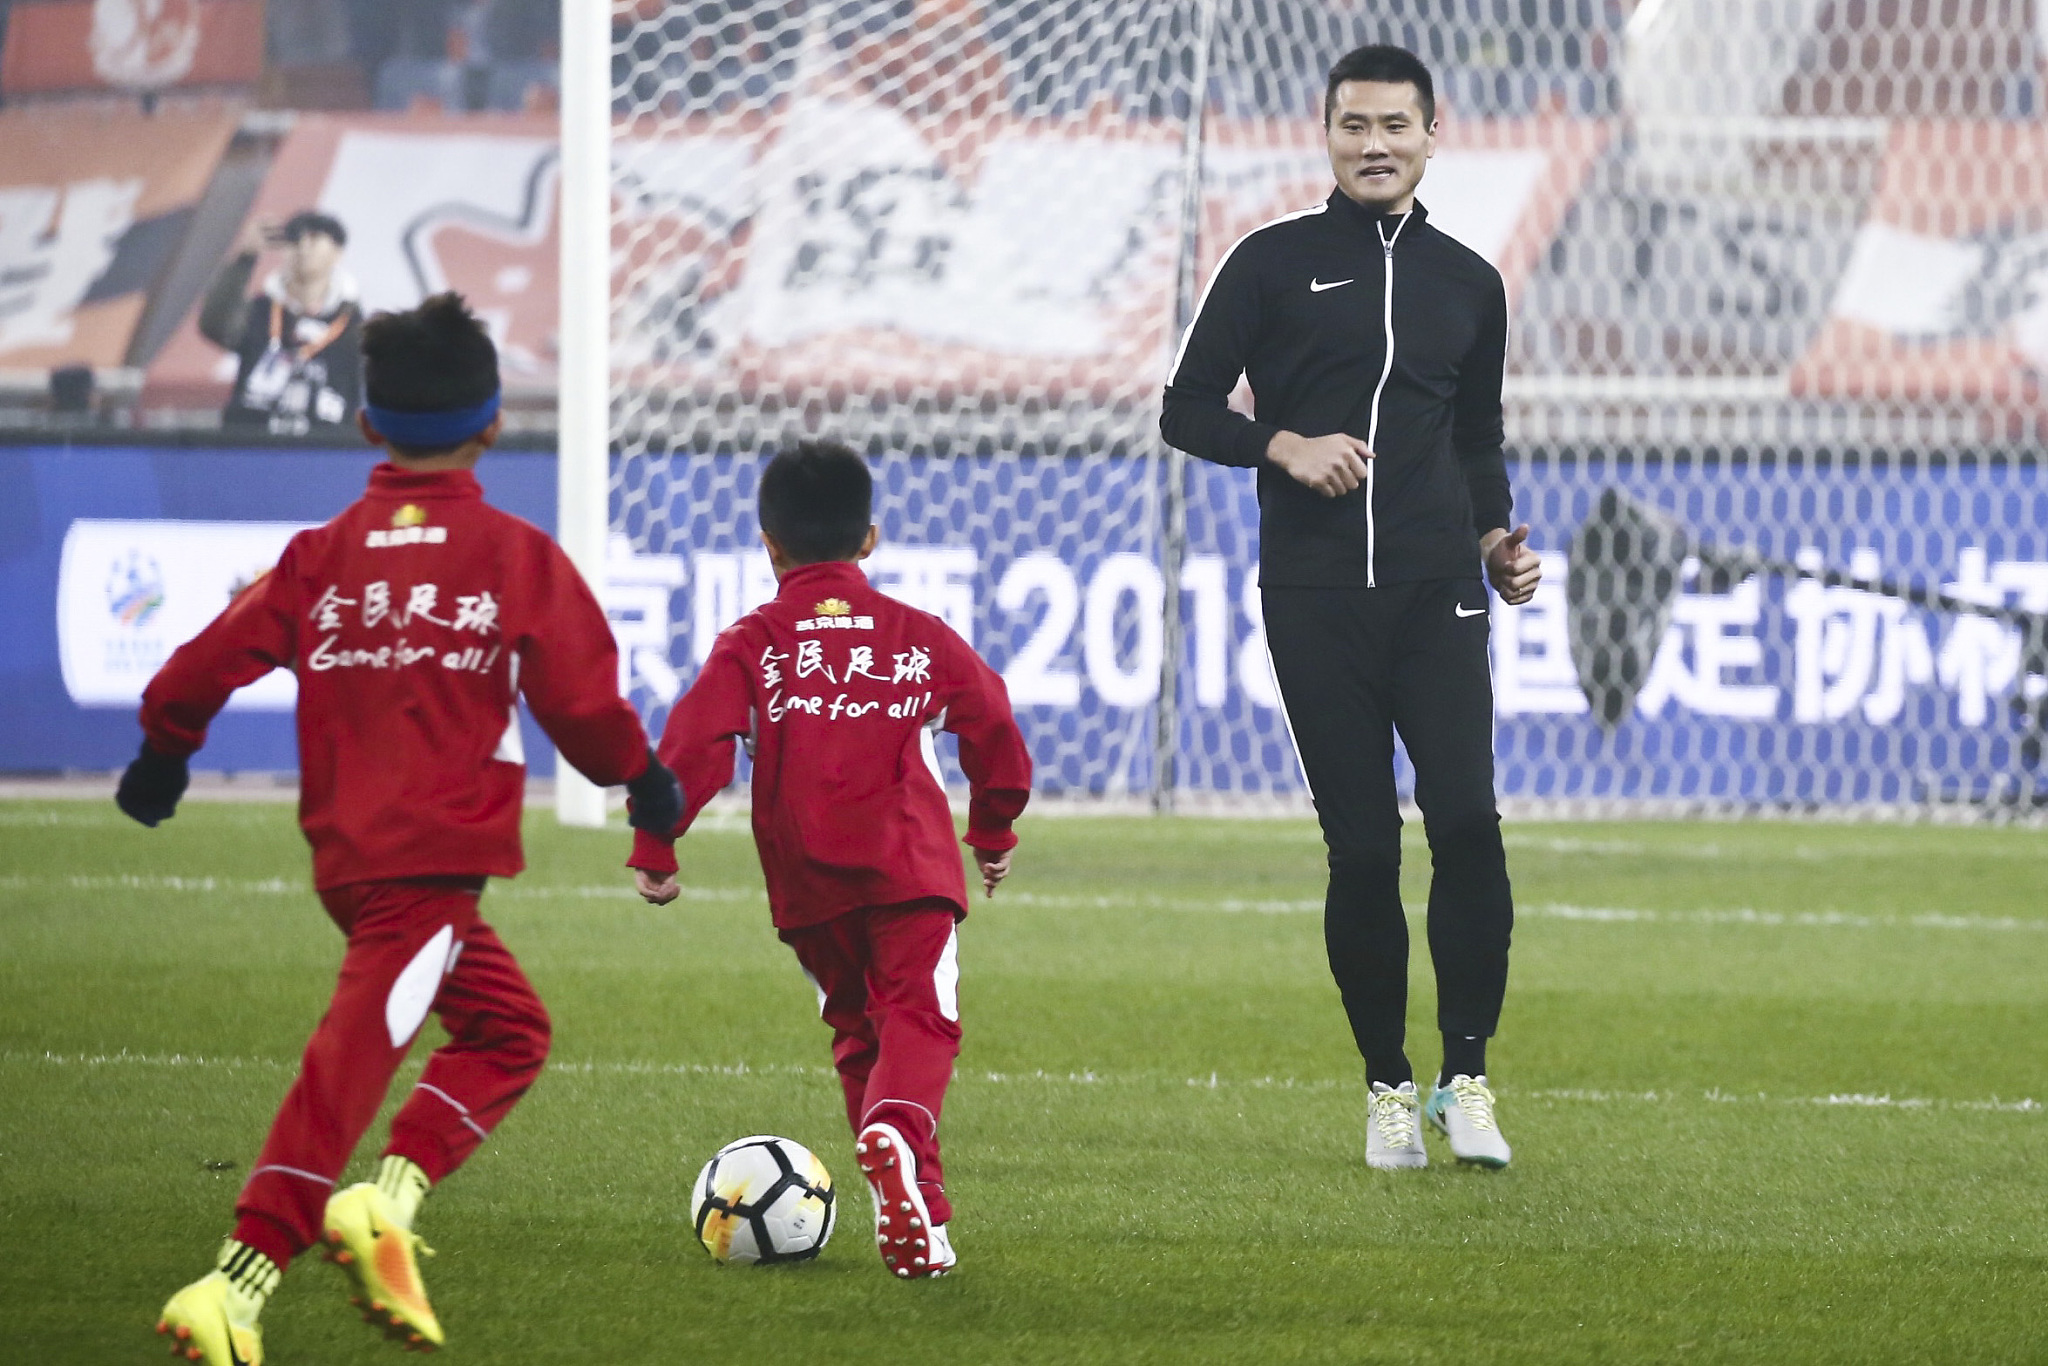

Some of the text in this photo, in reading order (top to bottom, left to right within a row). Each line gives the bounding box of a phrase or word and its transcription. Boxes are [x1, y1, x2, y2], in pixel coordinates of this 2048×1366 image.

[309, 580, 499, 636] 全民足球
[308, 634, 391, 670] Game
[760, 639, 931, 689] 全民足球
[767, 688, 823, 723] Gme
[828, 694, 880, 720] for
